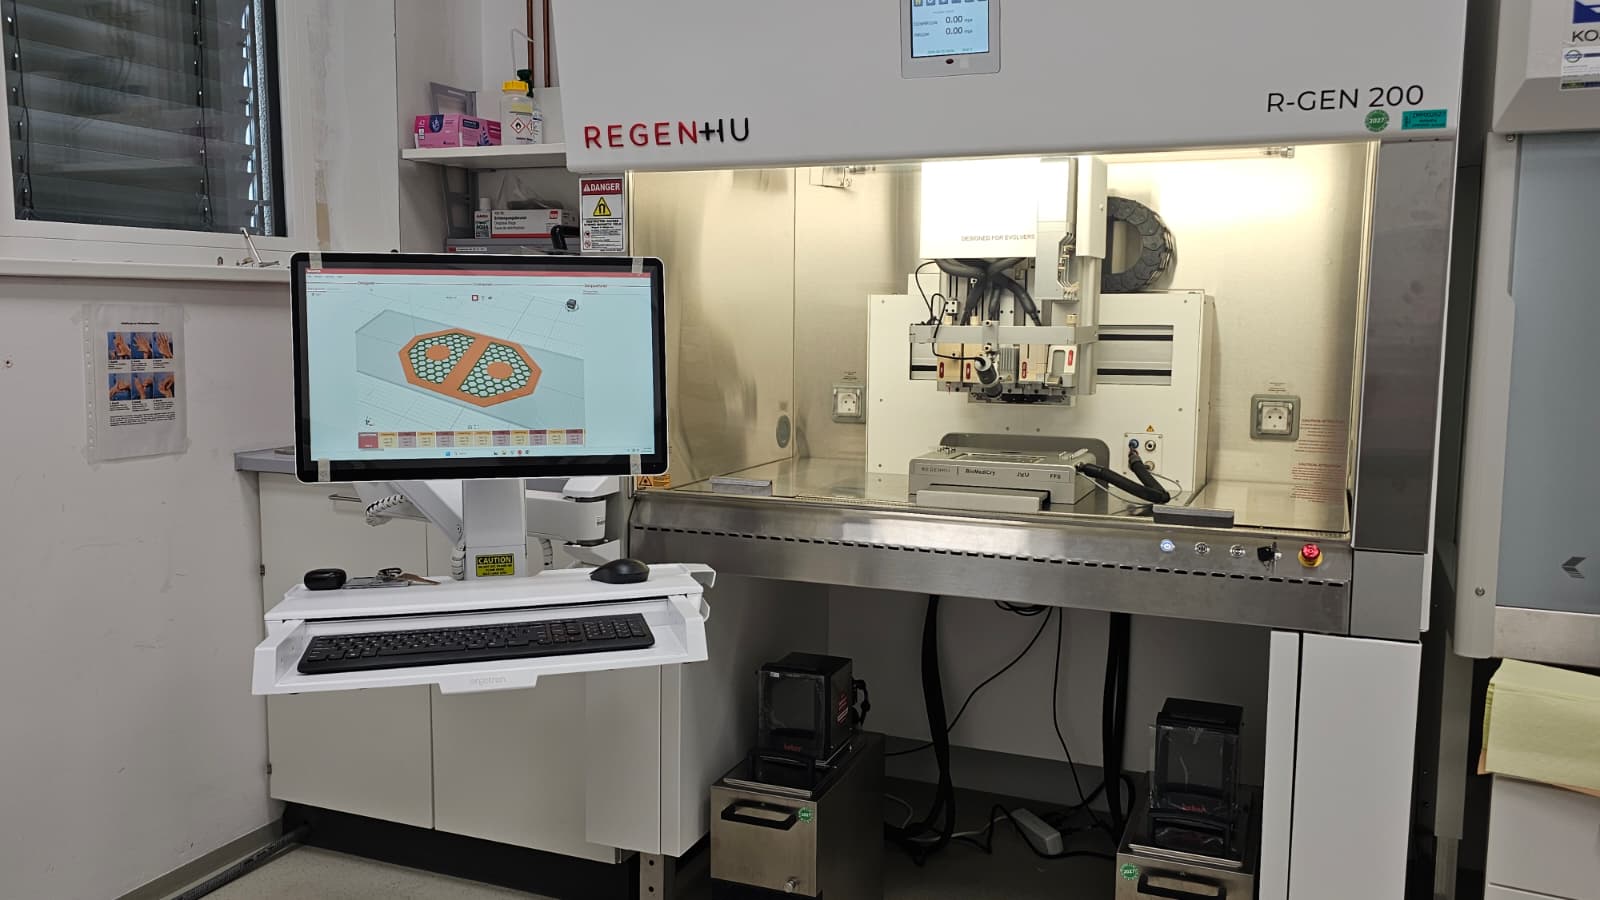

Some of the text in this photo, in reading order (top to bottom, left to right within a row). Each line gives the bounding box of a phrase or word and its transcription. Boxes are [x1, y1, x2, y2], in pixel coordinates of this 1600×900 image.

[945, 15, 963, 24] 0.00
[945, 26, 963, 35] 0.00
[1571, 29, 1600, 42] KO
[1267, 84, 1424, 113] R-GEN 200
[590, 182, 620, 192] DANGER
[478, 556, 511, 564] CAUTION
